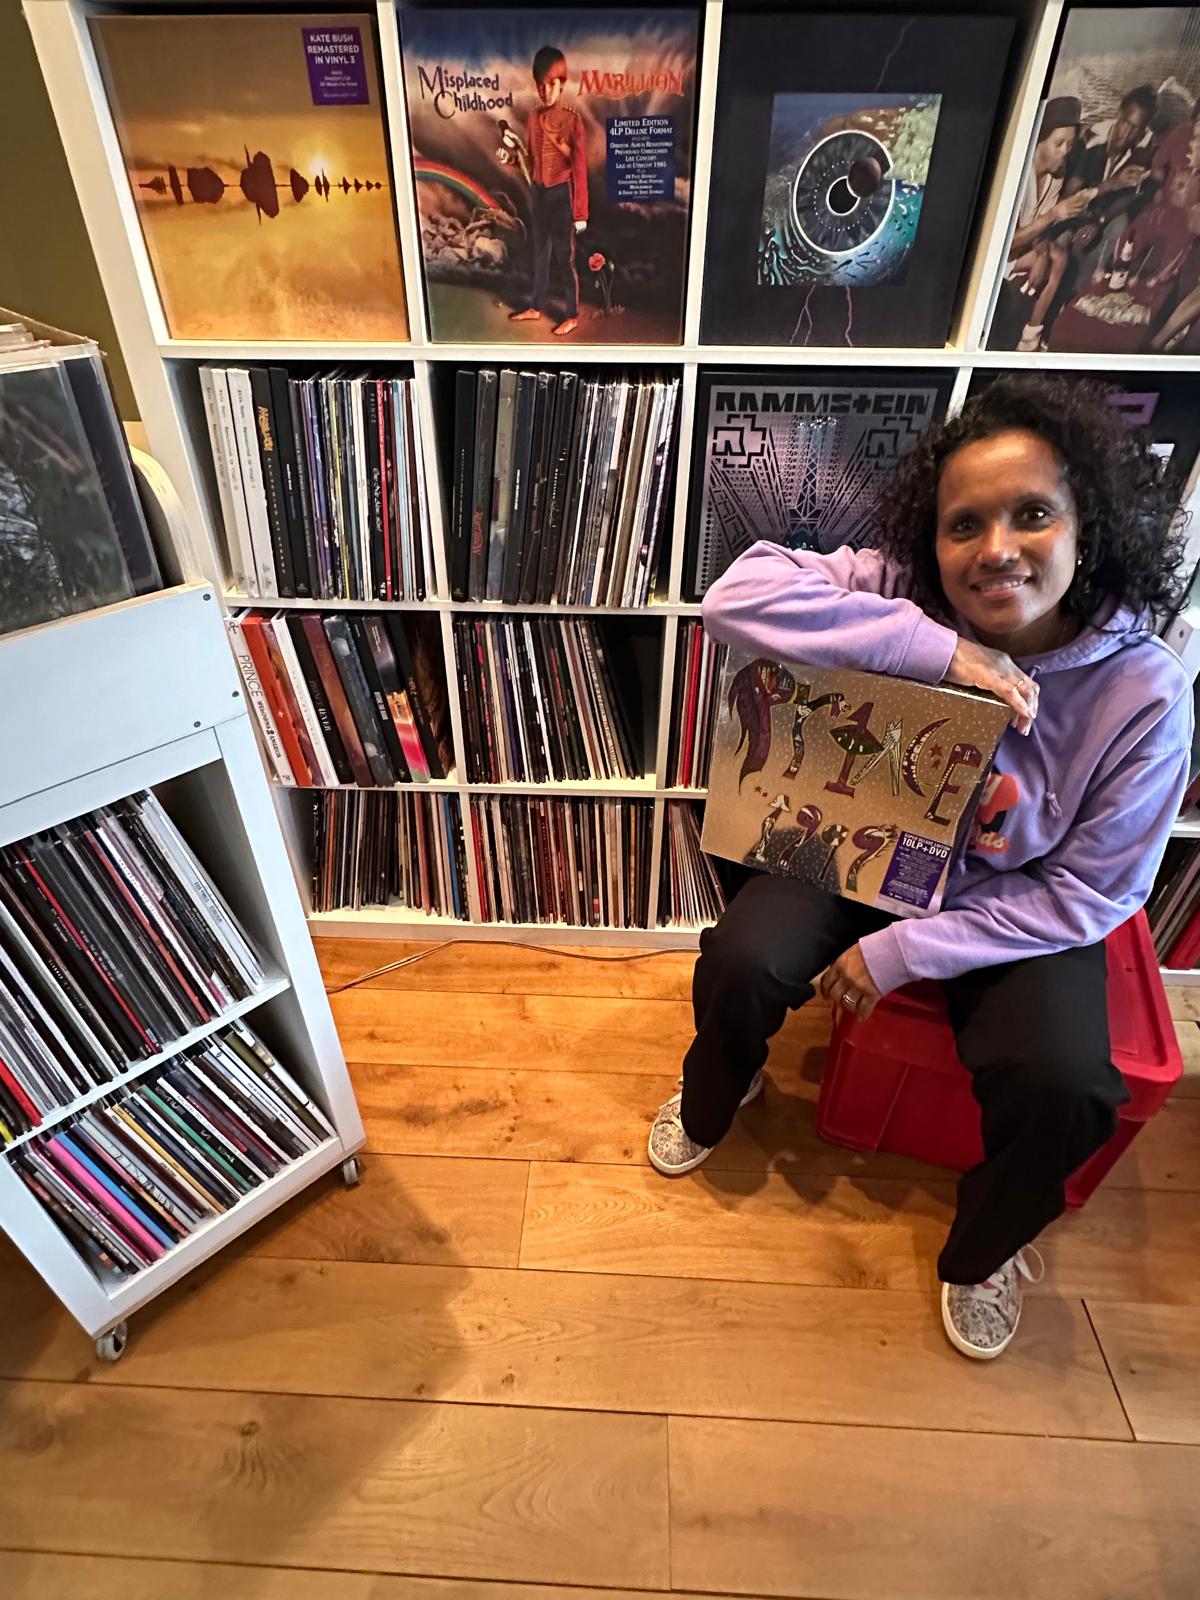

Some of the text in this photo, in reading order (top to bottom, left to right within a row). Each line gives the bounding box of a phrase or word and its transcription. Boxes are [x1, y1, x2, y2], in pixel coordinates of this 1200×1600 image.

[307, 45, 360, 54] REMASTERED
[310, 34, 354, 43] KATE BUSH
[315, 56, 324, 65] IN
[325, 56, 349, 64] VINYL
[418, 65, 500, 100] Misplaced
[578, 70, 686, 98] MARILLION
[434, 91, 514, 119] Childhood
[610, 127, 624, 136] 4LP
[368, 393, 376, 424] PRINCE
[715, 391, 930, 415] RAMMSTEIN
[238, 654, 263, 698] PRINCE
[750, 793, 899, 892] 1999
[902, 837, 948, 859] 10LP+DVD
